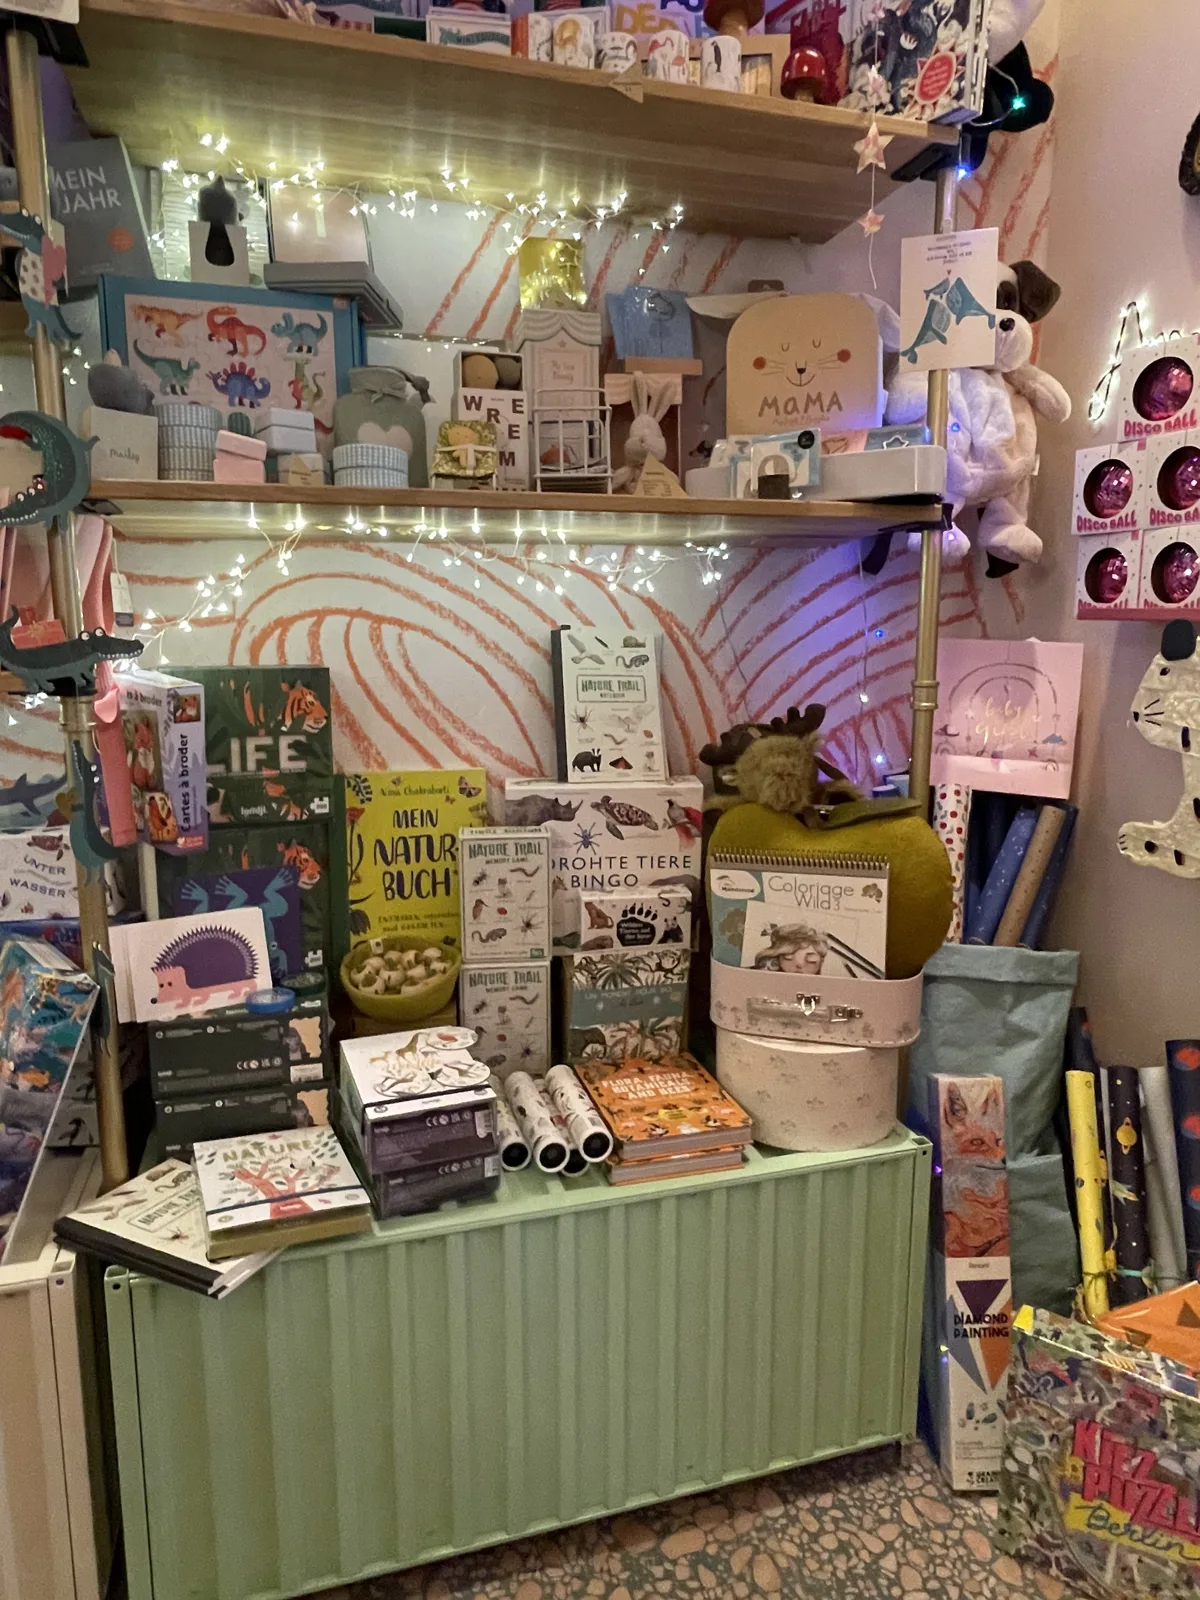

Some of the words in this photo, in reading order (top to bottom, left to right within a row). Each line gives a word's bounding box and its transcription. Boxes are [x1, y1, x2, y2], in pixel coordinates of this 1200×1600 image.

[62, 187, 122, 214] JAHR
[1123, 419, 1162, 437] DISCO
[1164, 408, 1198, 430] BALL
[1076, 515, 1108, 532] DISCO
[1110, 510, 1137, 528] BALL
[1150, 507, 1182, 526] DISCO
[581, 680, 614, 693] NATURE
[617, 680, 641, 692] TRAIL
[178, 734, 190, 777] broder
[181, 793, 191, 833] Cartes
[393, 808, 439, 829] MEIN
[468, 842, 510, 859] NATURE
[514, 841, 544, 856] TRAIL
[23, 854, 66, 875] UNTER
[636, 855, 692, 869] TIERE
[9, 878, 66, 898] WASSER
[382, 867, 451, 901] BUCH
[571, 873, 639, 888] BINGO
[469, 971, 509, 987] NATURE
[514, 971, 542, 984] TRAIL
[627, 1090, 656, 1100] AND
[222, 1140, 313, 1162] NATURE
[953, 1311, 1008, 1326] DIAMOND
[953, 1327, 1010, 1339] PAINTING
[1082, 1465, 1200, 1546] PUZZL
[1075, 1502, 1200, 1562] Berlin
